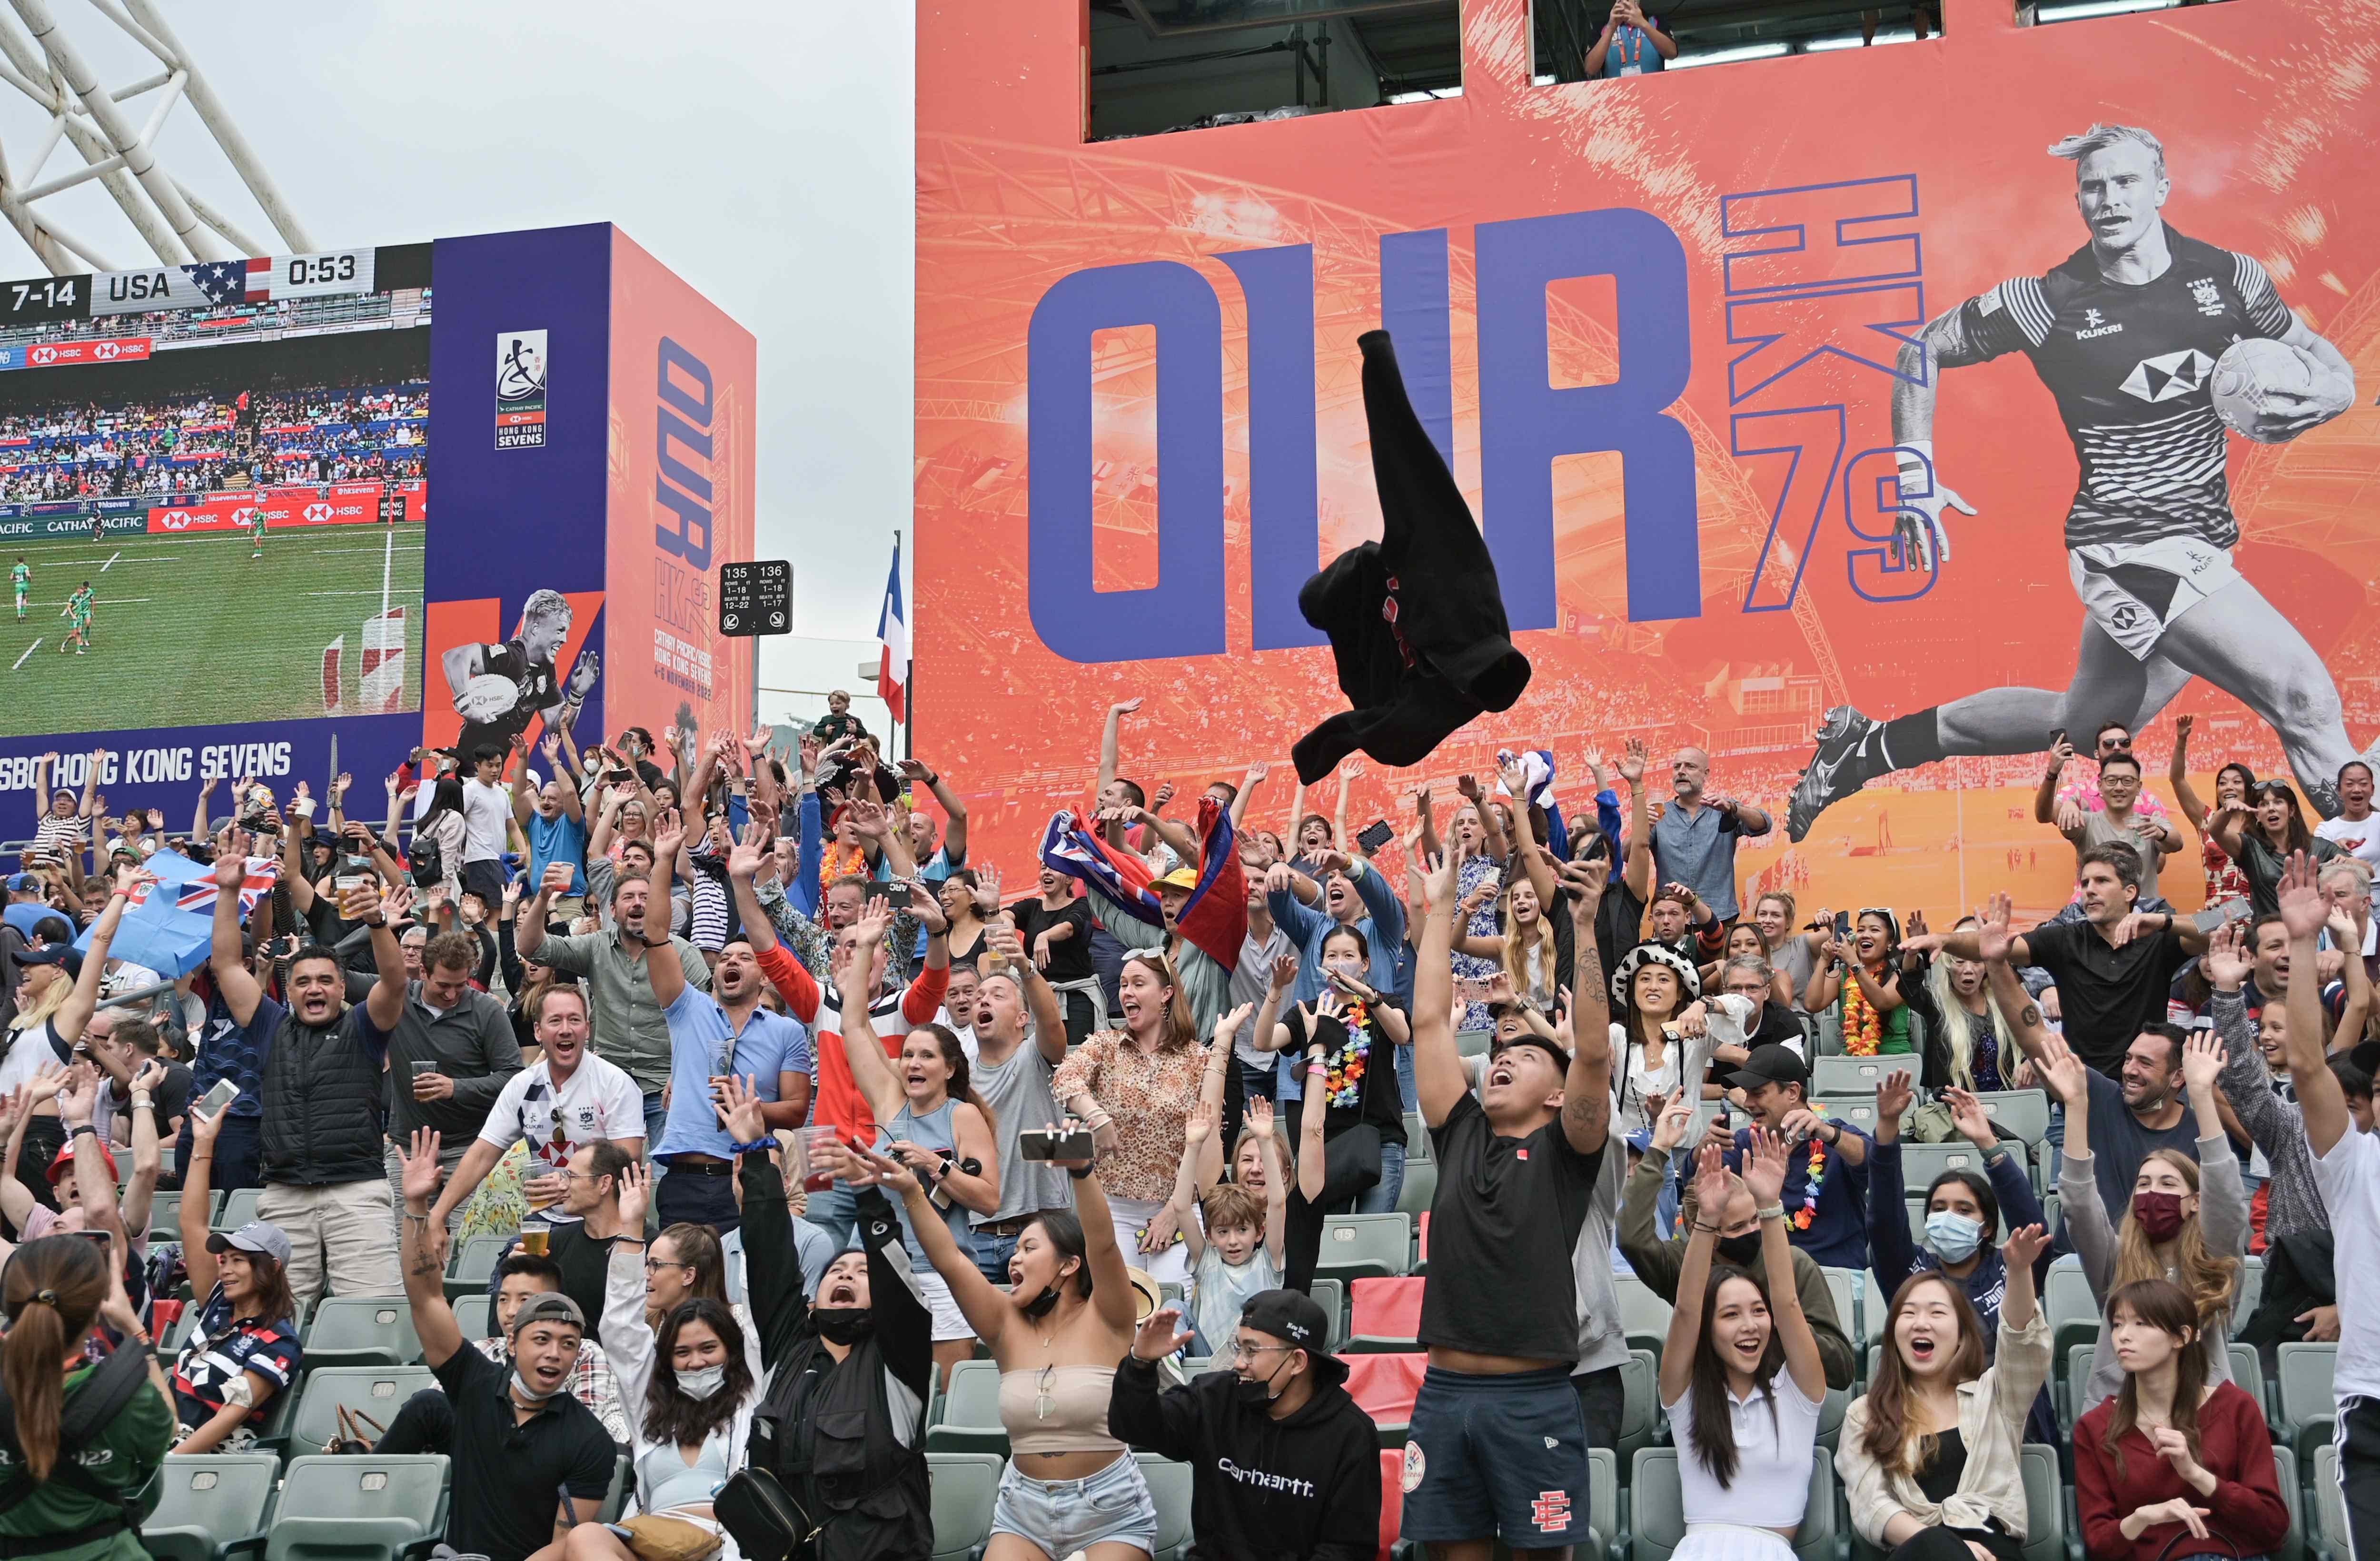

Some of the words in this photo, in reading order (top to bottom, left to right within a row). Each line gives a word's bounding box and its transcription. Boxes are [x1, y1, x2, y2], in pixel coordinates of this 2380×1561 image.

[289, 255, 355, 285] 0:53
[109, 273, 171, 302] USA
[12, 281, 76, 311] 7-14
[2076, 324, 2122, 340] KUKRI
[59, 348, 81, 358] HSBC
[121, 344, 144, 354] HSBC
[499, 427, 519, 435] HONG
[523, 425, 542, 433] KONG
[1028, 207, 1702, 664] OUR
[498, 434, 542, 446] SEVENS
[655, 336, 713, 571] OUR
[208, 493, 252, 502] hksevens.com
[336, 506, 363, 516] HSBC
[193, 514, 218, 523] HSBC
[47, 519, 93, 532] CATHAY
[726, 567, 747, 578] 135
[761, 566, 782, 577] 136
[654, 628, 676, 651] CATHAY
[654, 646, 671, 667] HONG
[673, 654, 689, 676] KONG
[691, 663, 712, 686] SEVENS
[667, 671, 695, 694] NOVEMBER
[696, 684, 711, 702] 2022
[126, 748, 193, 785] KONG
[200, 742, 292, 780] SEVENS
[1863, 1067, 1874, 1075] 19
[1854, 1109, 1866, 1117] 19
[1951, 1157, 1964, 1166] 19
[1339, 1230, 1351, 1239] 15
